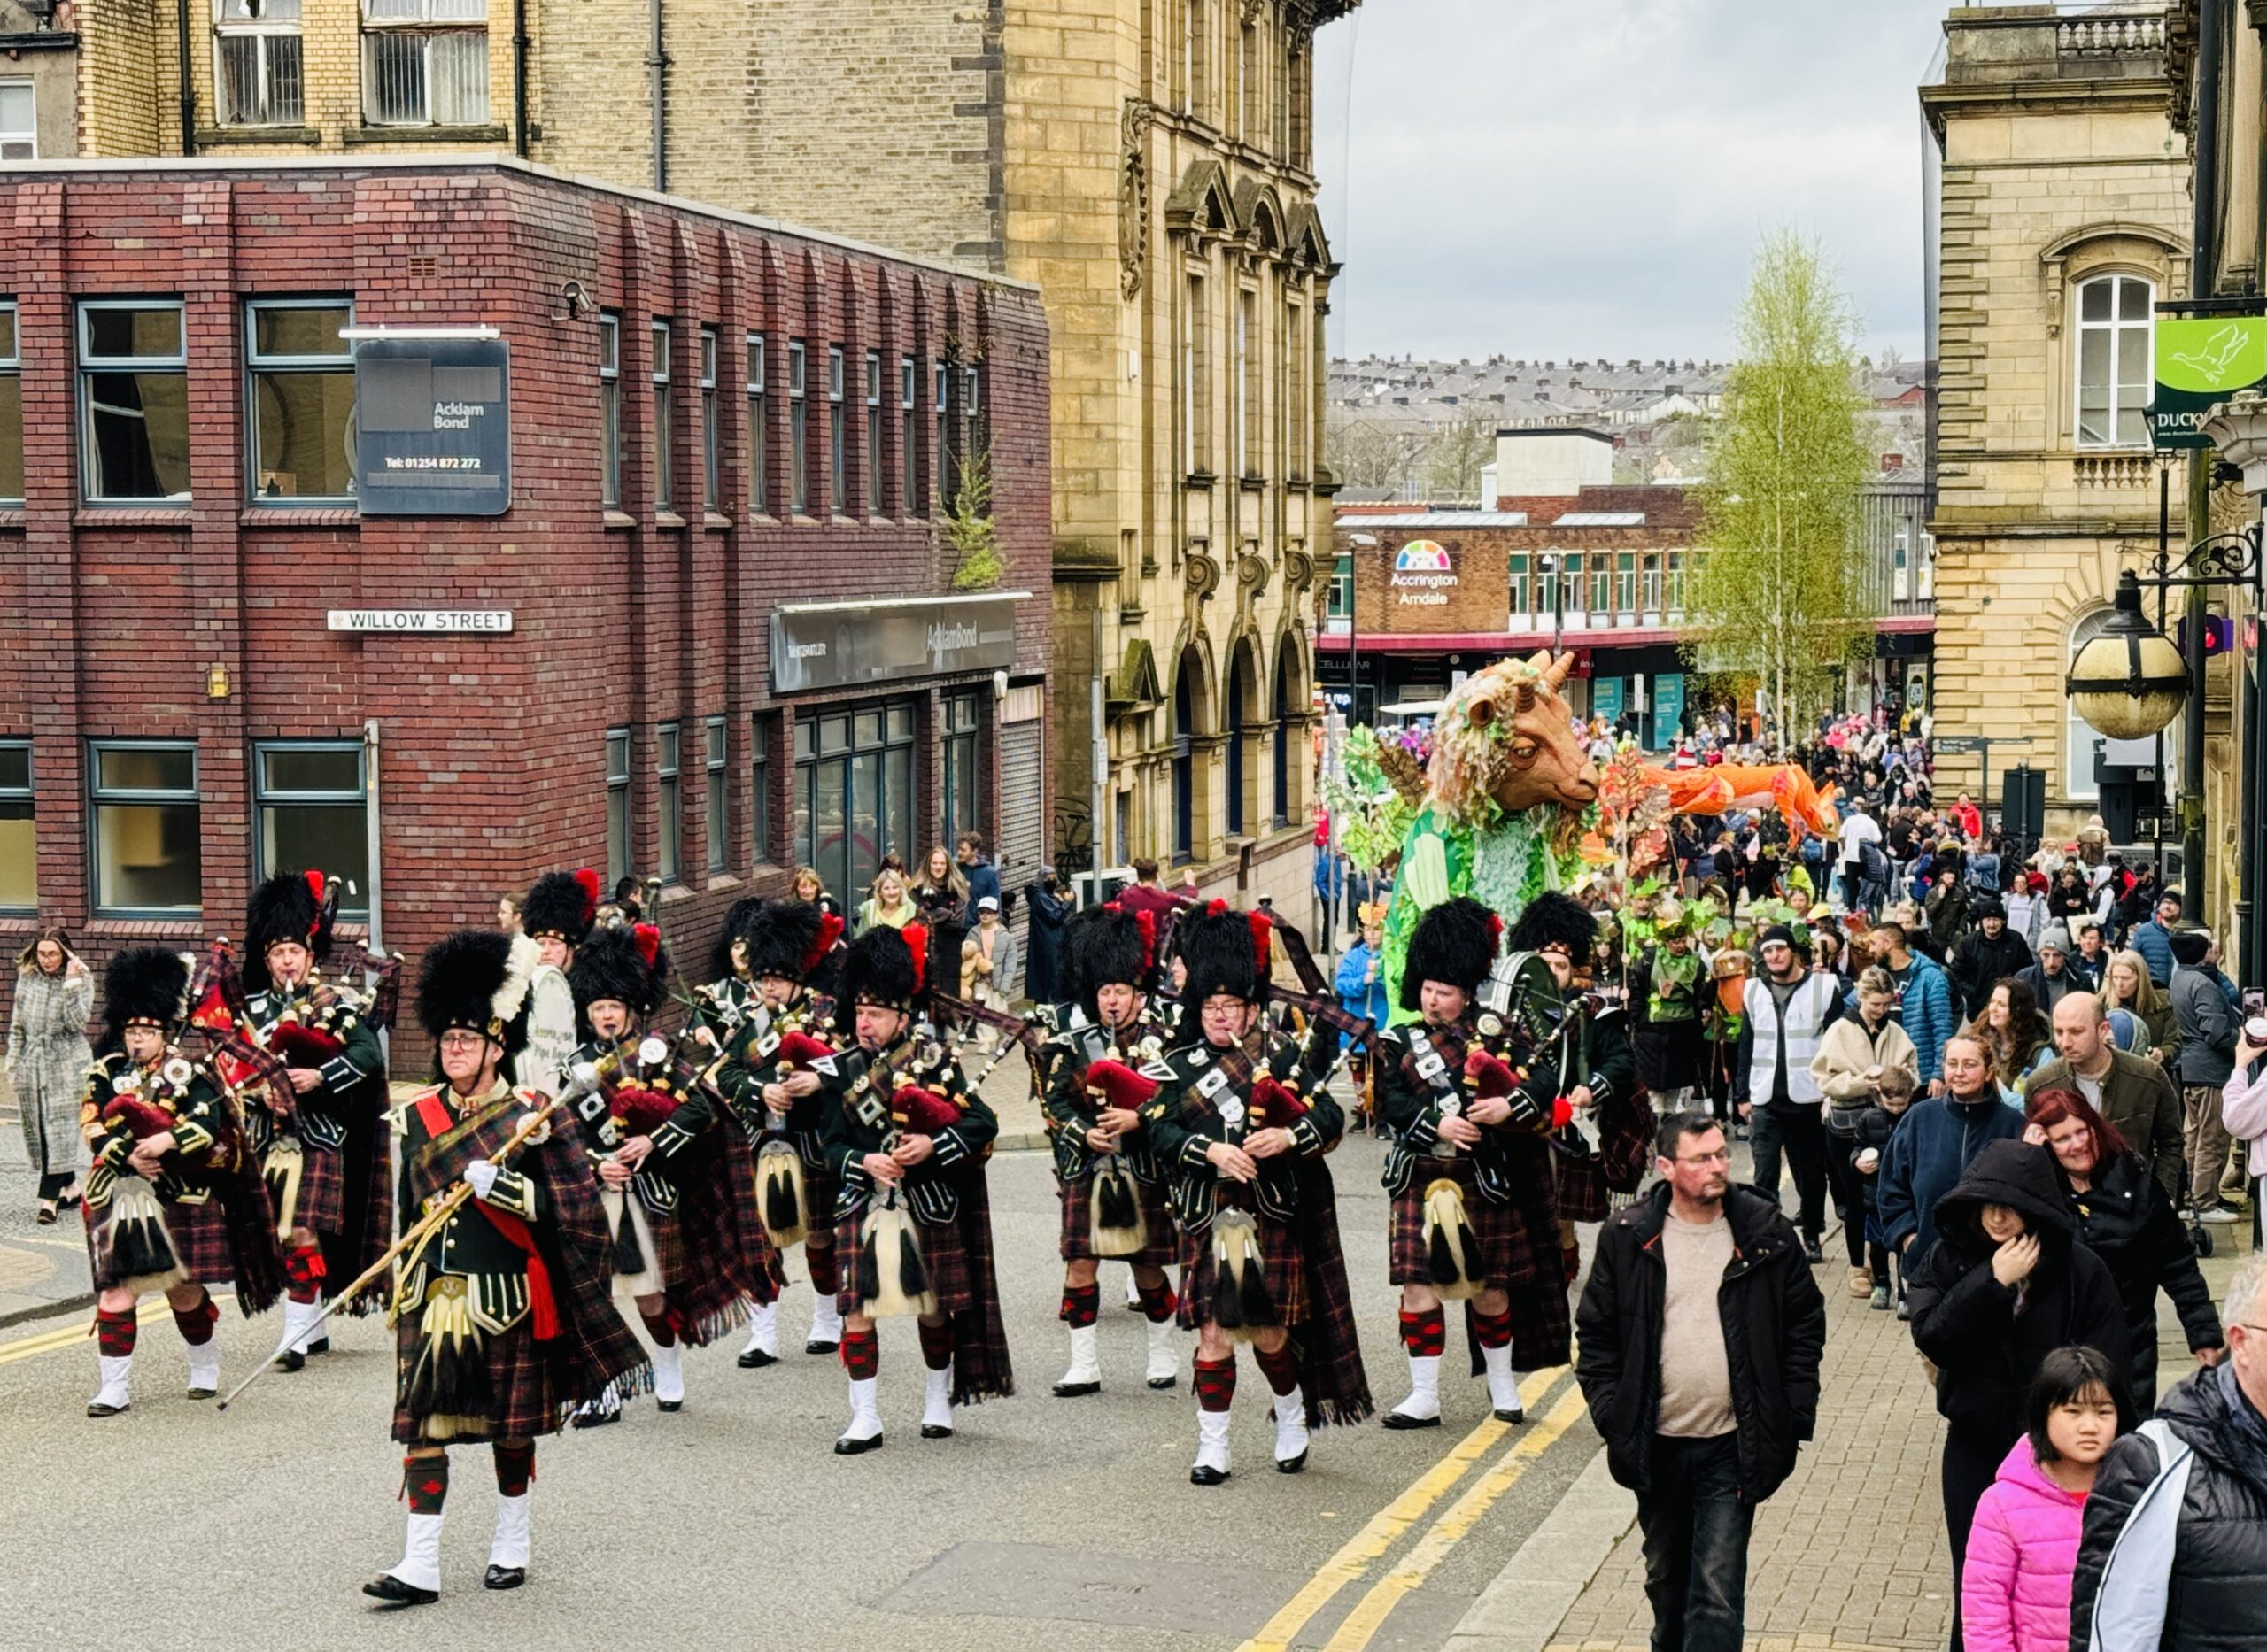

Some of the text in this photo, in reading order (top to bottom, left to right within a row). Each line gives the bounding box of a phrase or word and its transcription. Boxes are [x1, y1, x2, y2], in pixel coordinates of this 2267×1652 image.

[434, 402, 484, 416] Acklam
[434, 416, 469, 429] Bond
[384, 457, 481, 468] Tel: 01254 872 272
[1390, 573, 1458, 589] Accrington
[1399, 592, 1448, 606] Arndale
[349, 614, 507, 629] WILLOW STREET
